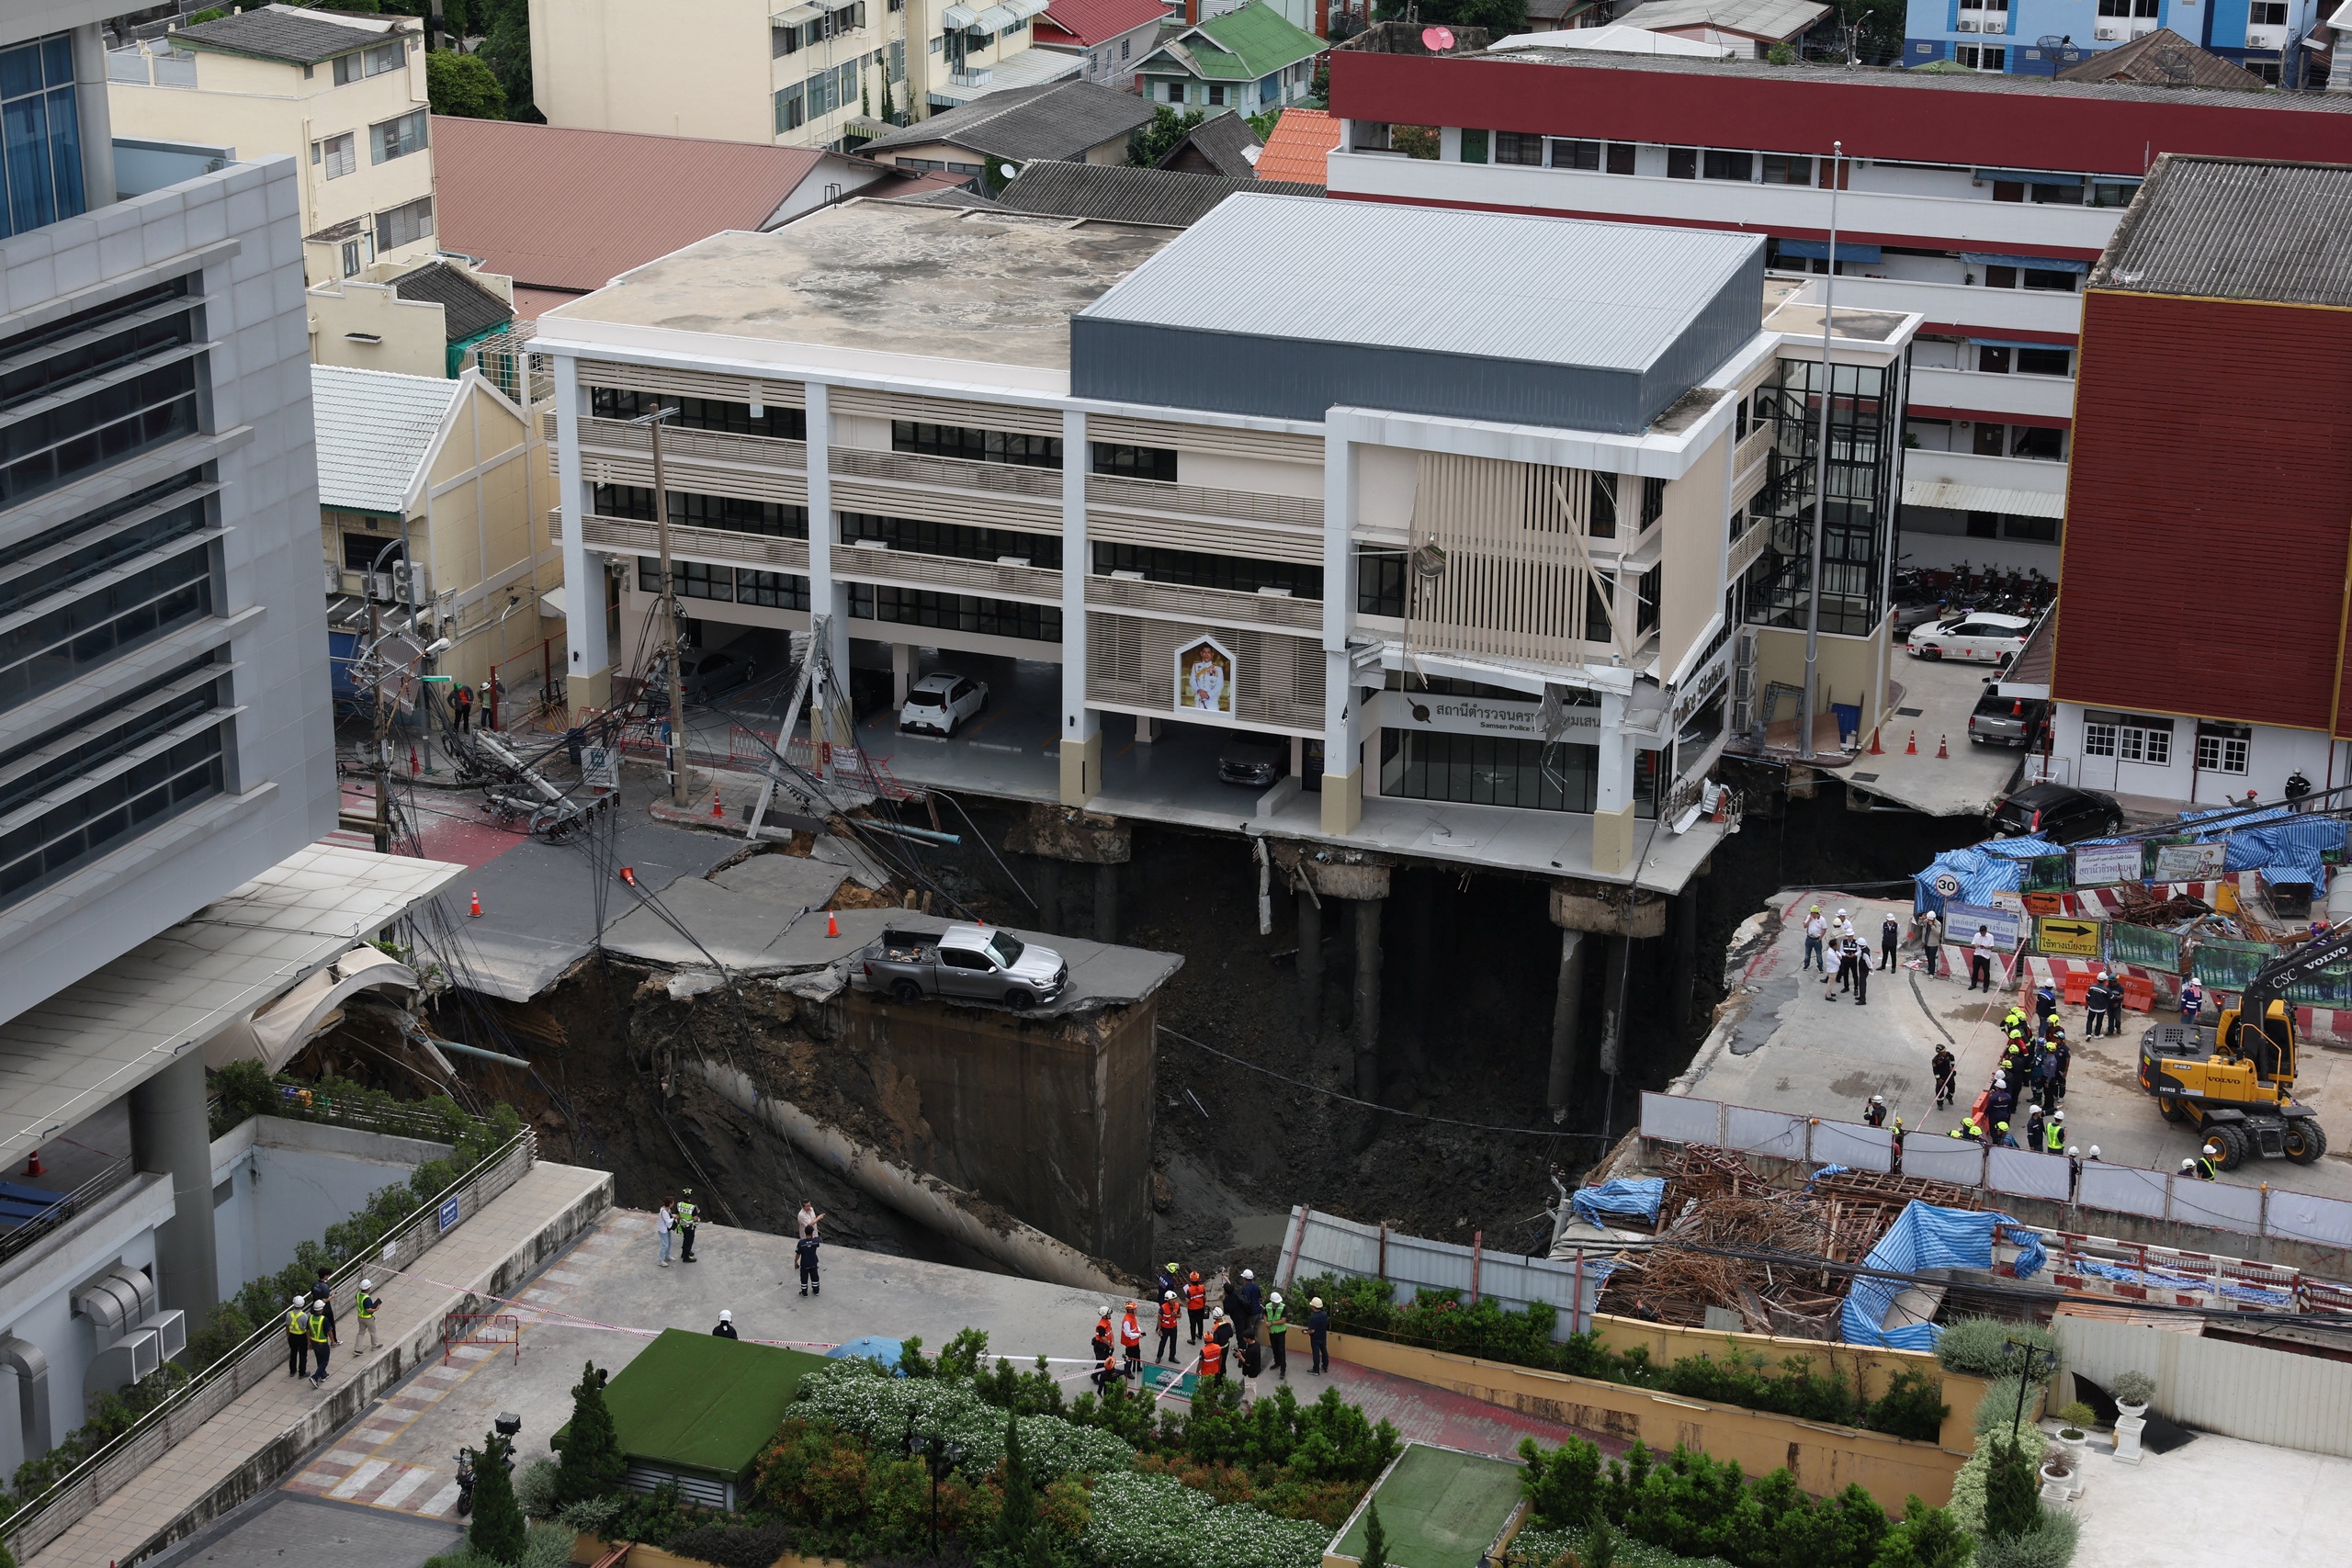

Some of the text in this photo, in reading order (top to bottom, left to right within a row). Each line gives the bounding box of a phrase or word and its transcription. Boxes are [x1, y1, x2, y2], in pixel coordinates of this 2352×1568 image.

[1436, 703, 1600, 728] สถานีตำรวจนครามเสน
[1480, 721, 1508, 730] Samsen
[1509, 724, 1531, 733] Police
[1938, 879, 1956, 892] 30
[2303, 946, 2348, 970] VOLVO
[2272, 968, 2298, 989] CSC
[2207, 1076, 2241, 1085] VOLVO
